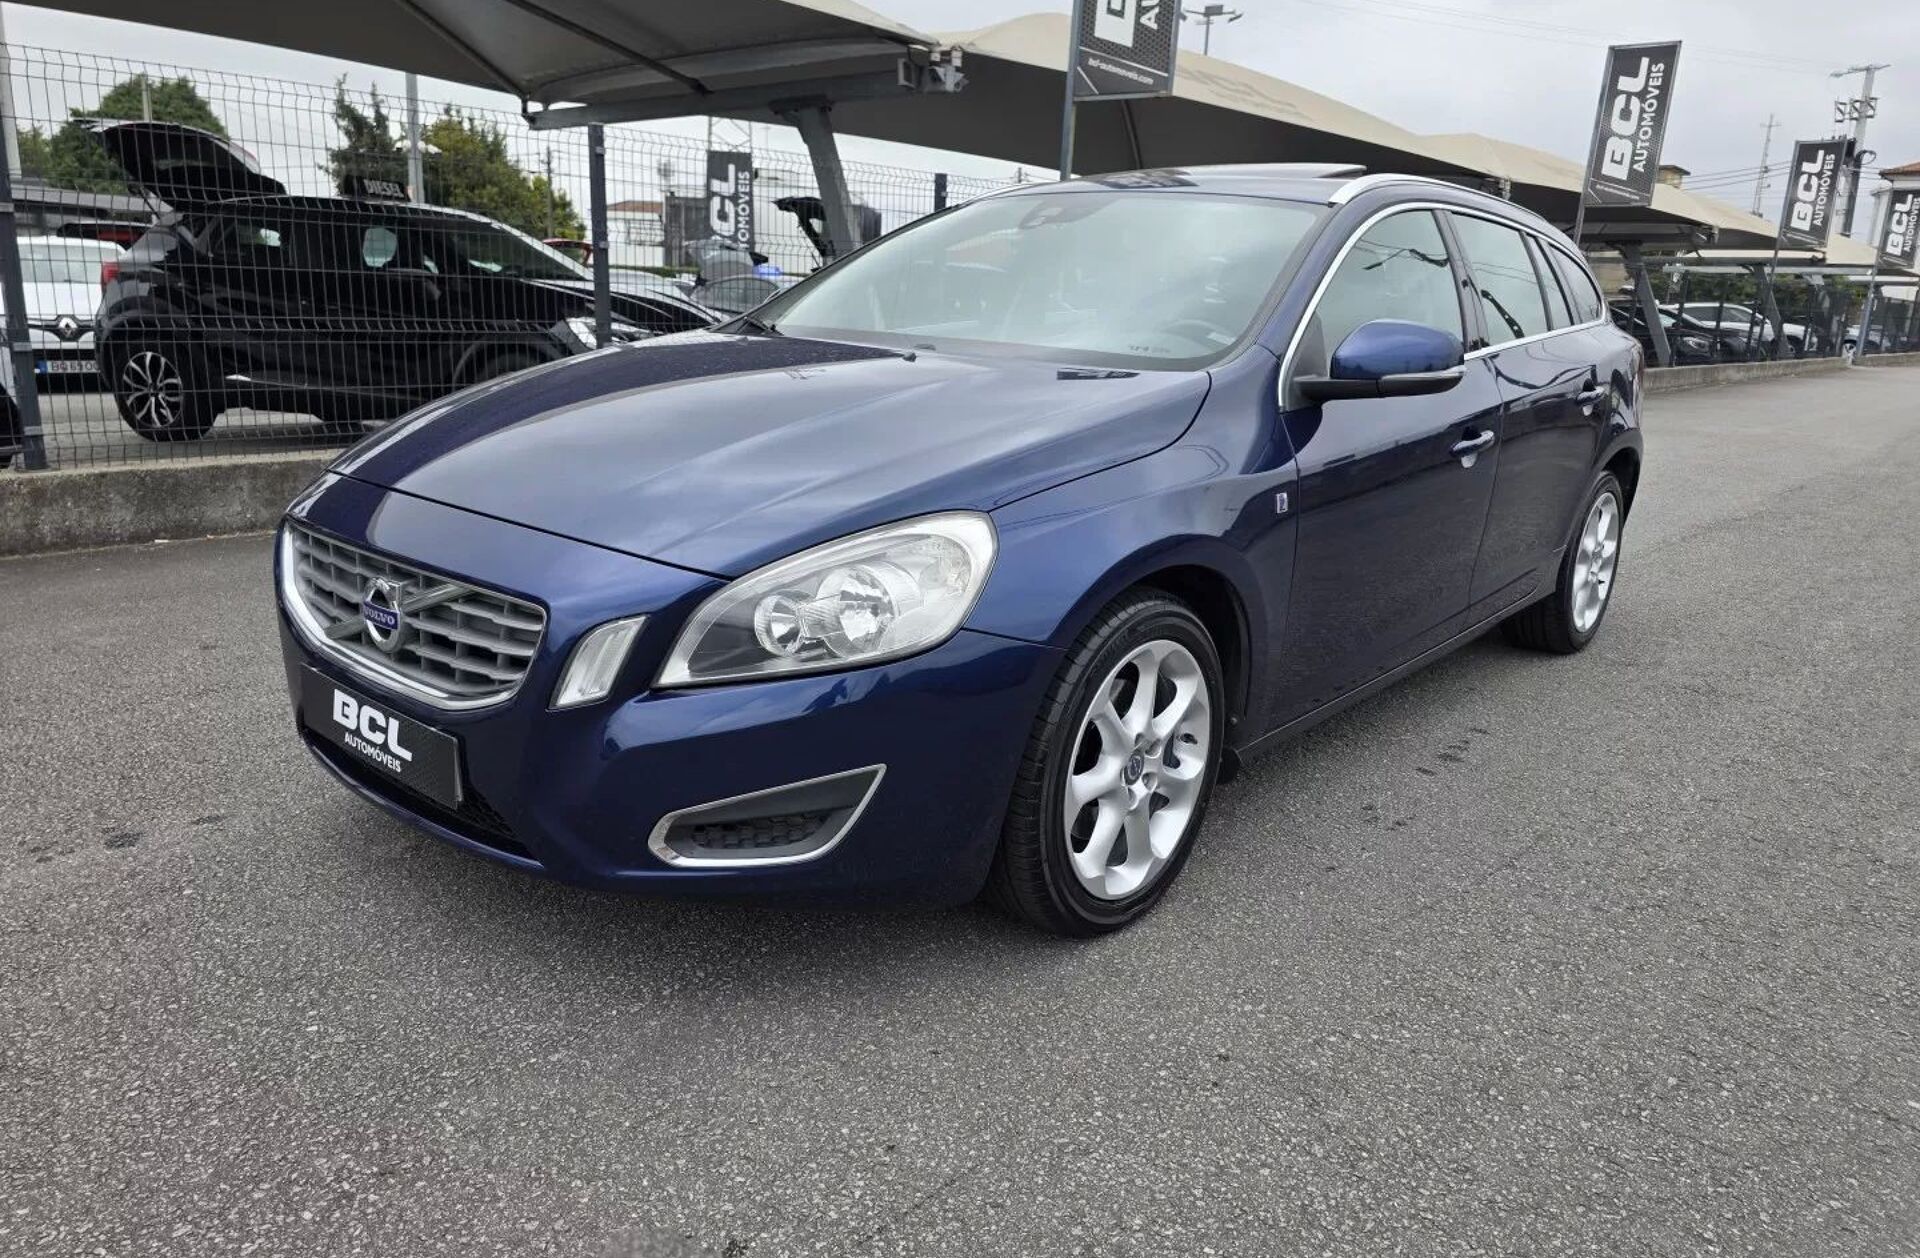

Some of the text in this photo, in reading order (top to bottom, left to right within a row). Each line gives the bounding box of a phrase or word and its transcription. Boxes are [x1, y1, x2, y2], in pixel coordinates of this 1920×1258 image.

[1601, 56, 1650, 180] BCL
[1632, 62, 1665, 172] AUTOMÓVEIS
[710, 163, 736, 240] CL
[1790, 149, 1825, 231] BCL
[1812, 153, 1836, 226] AUTOMÓVEIS
[1885, 193, 1914, 256] BCL
[363, 605, 396, 626] VOLVO
[333, 688, 413, 762] BCL
[344, 731, 402, 773] AUTOMÓVEIS
